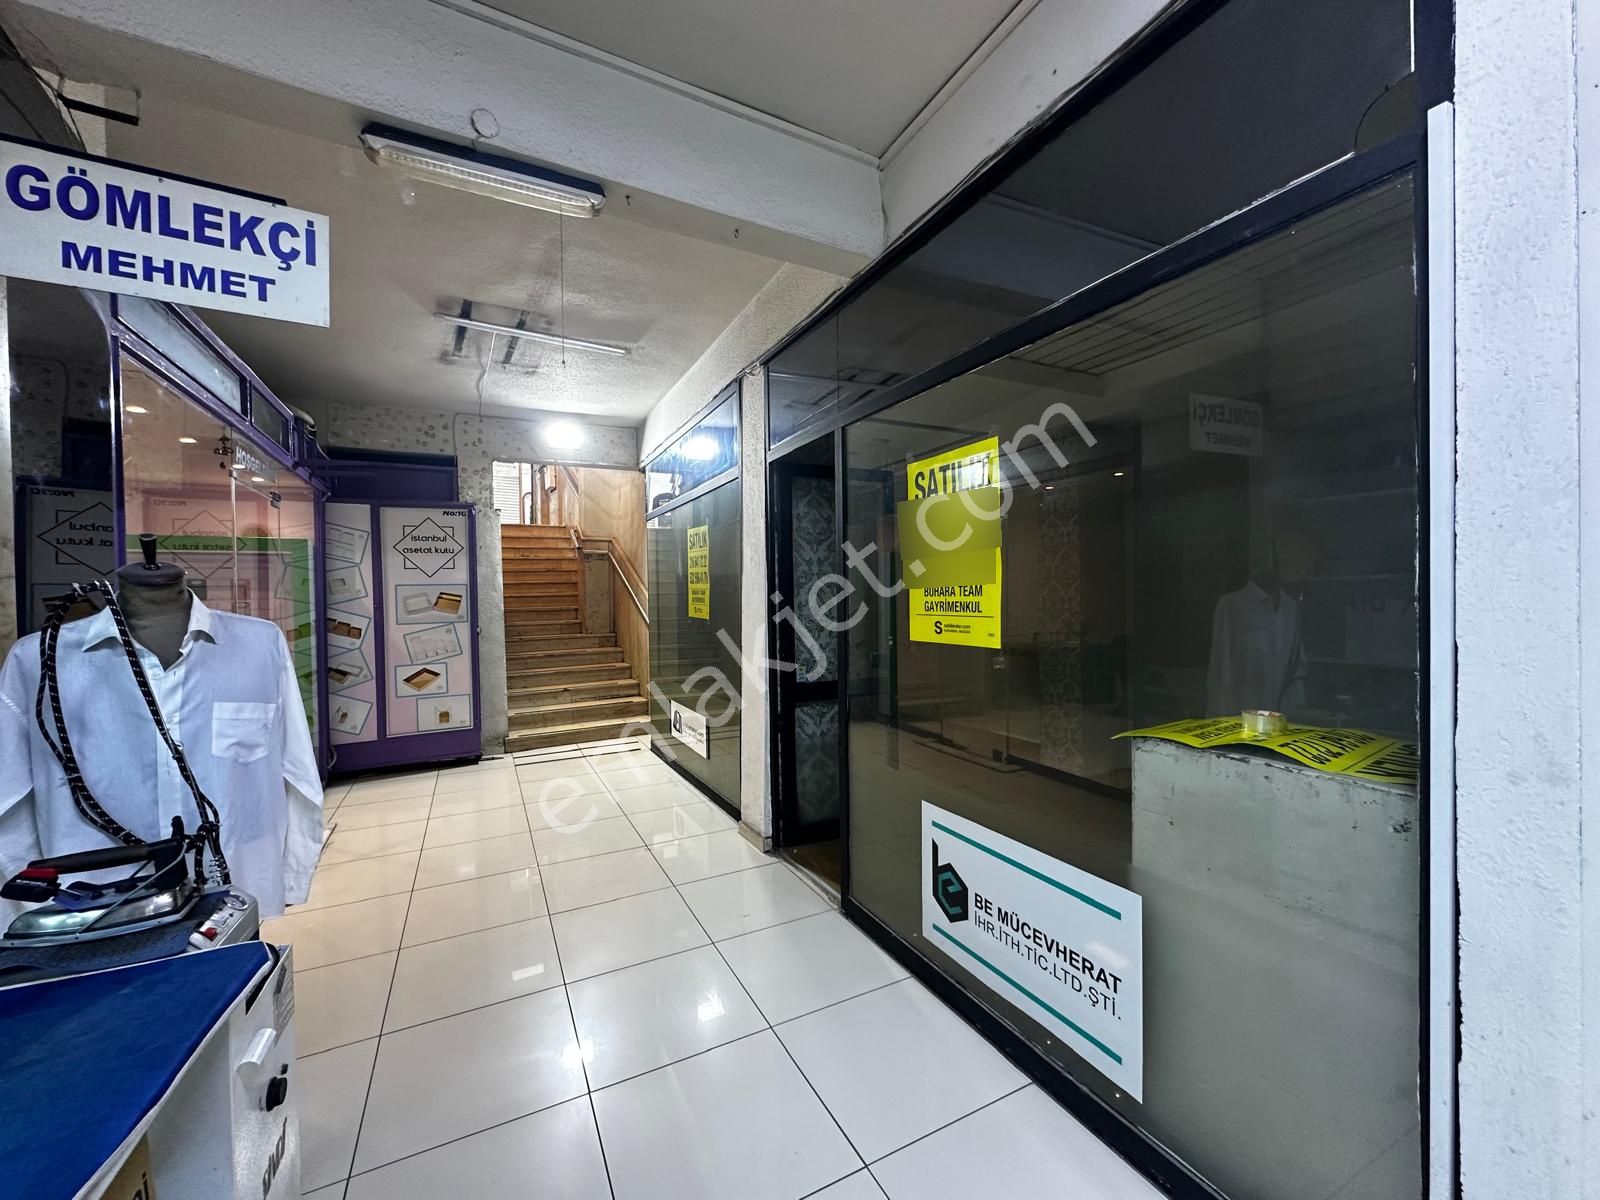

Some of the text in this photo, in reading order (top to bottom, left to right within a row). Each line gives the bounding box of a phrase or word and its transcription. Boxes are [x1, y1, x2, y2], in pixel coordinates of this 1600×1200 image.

[5, 164, 317, 272] GÖMLEKÇİ
[61, 240, 276, 302] MEHMET
[411, 534, 447, 542] istanbul
[402, 546, 455, 554] asetat kutu
[958, 584, 983, 597] TEAM
[924, 598, 983, 613] GAYRİMENKUL
[974, 892, 1122, 994] BE MÜCEVHERAT
